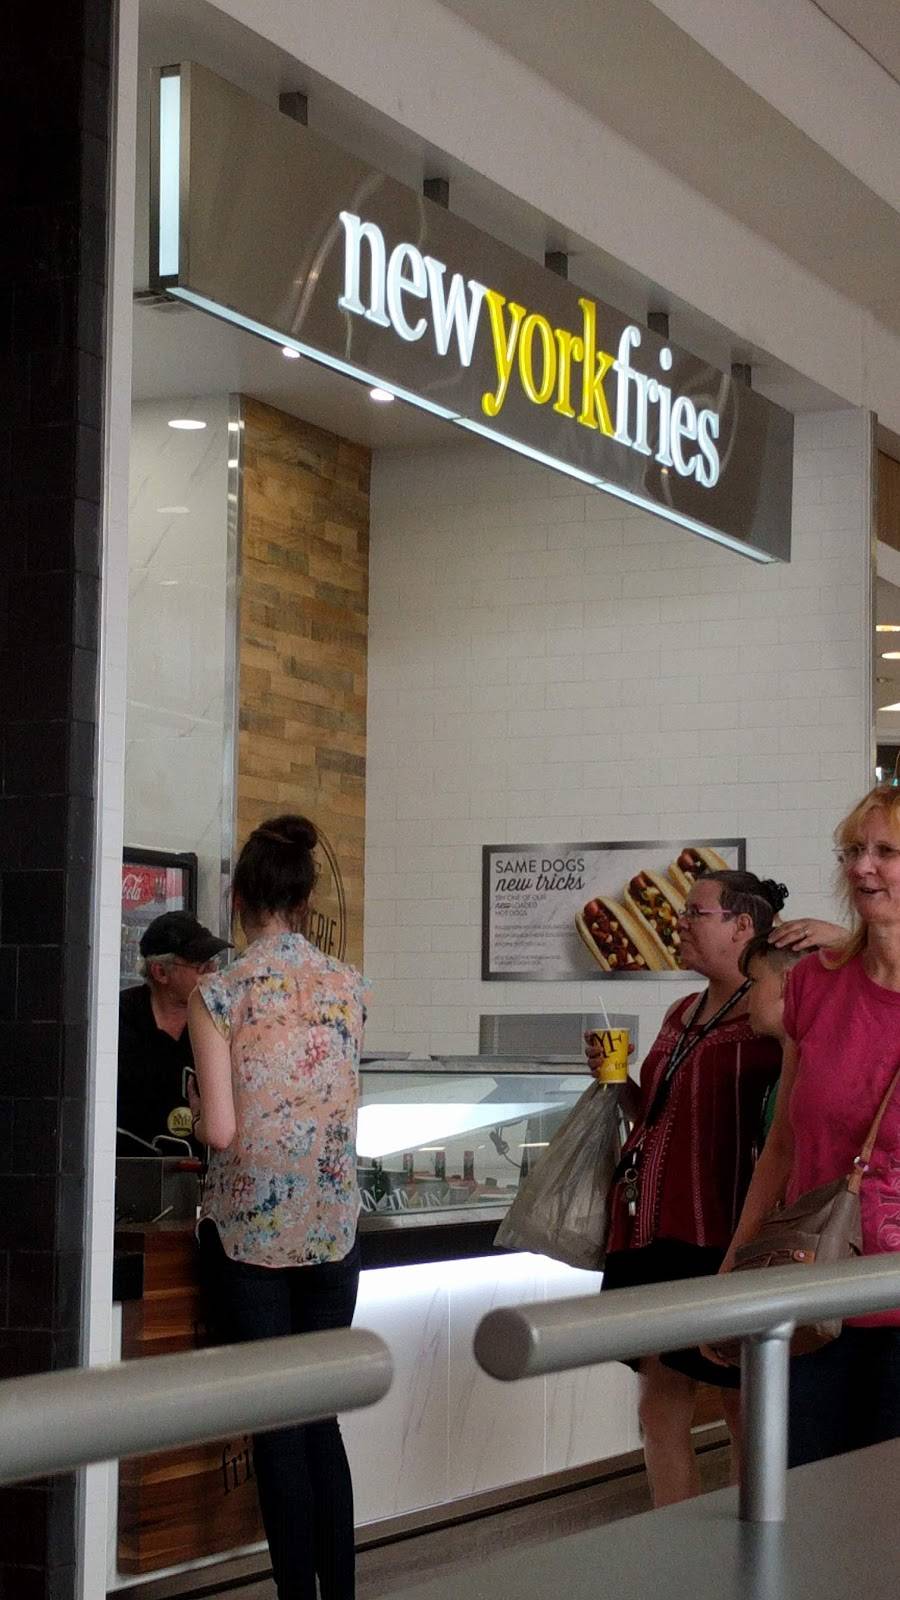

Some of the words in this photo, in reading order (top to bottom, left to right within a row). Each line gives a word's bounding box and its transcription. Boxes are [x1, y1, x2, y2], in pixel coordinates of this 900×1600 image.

[495, 860, 537, 873] SAME
[541, 858, 585, 872] DOGS
[495, 878, 533, 892] new
[535, 873, 586, 891] tricks
[308, 909, 337, 955] ERIE
[223, 1434, 252, 1496] fri
